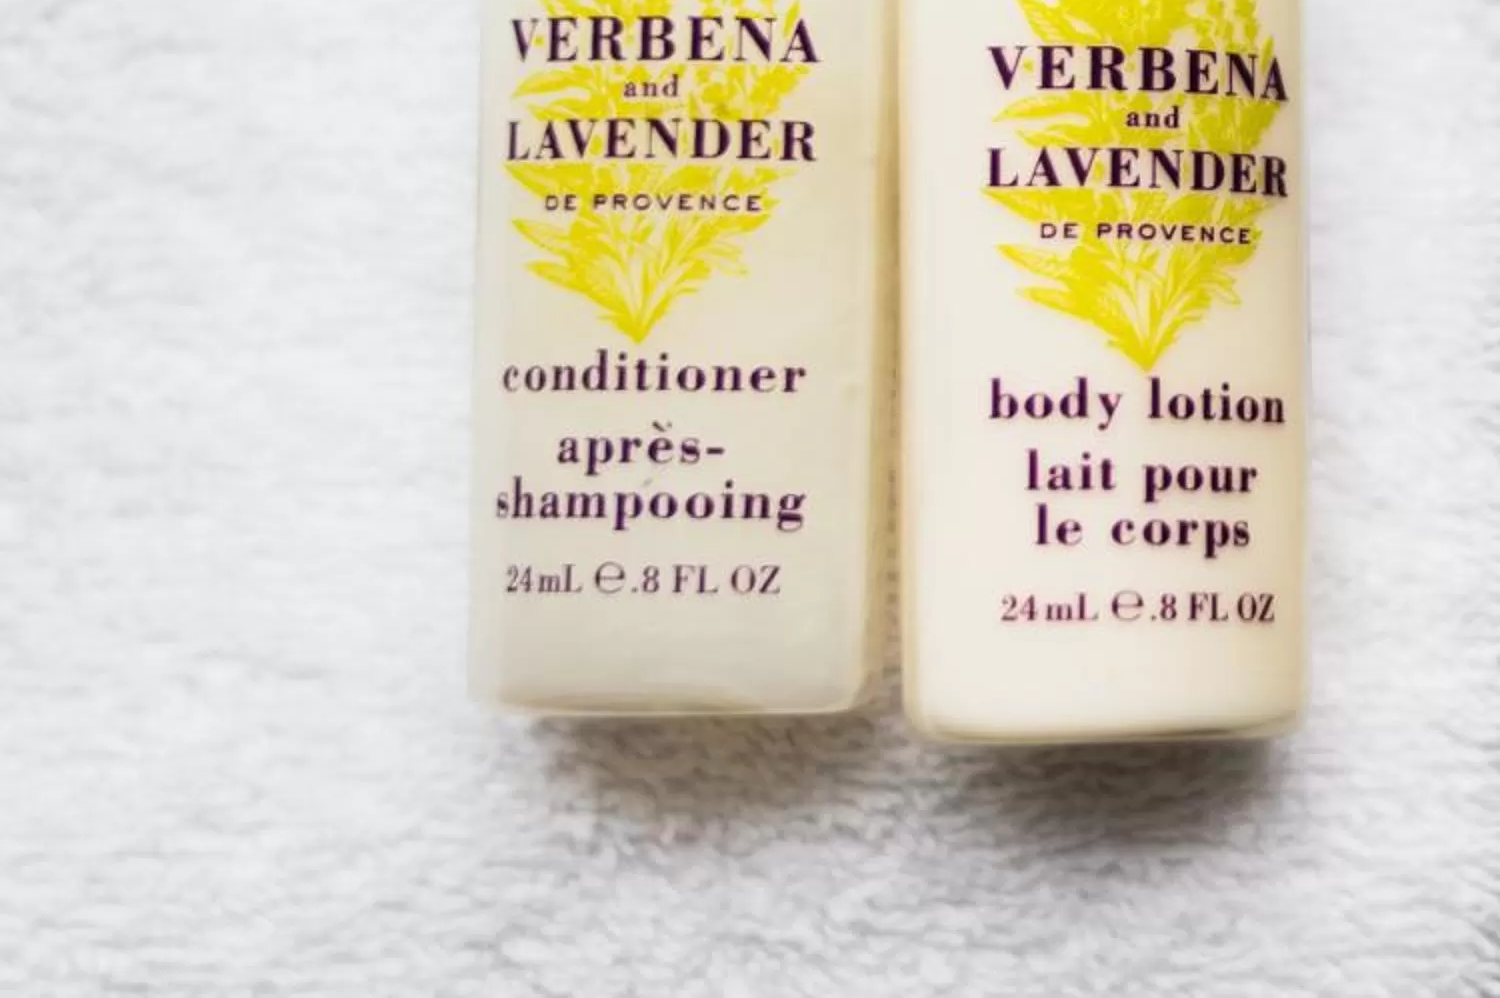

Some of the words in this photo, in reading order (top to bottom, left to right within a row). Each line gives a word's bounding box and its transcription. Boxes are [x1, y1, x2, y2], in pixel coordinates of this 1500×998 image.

[510, 15, 821, 63] VERBENA
[623, 74, 679, 98] and
[987, 45, 1289, 101] VERBENA
[507, 118, 817, 161] LAVENDER
[1125, 106, 1180, 129] and
[987, 147, 1288, 197] LAVENDER
[545, 195, 577, 211] DE
[594, 194, 761, 212] PROVENCE
[1040, 223, 1077, 239] DE
[1097, 223, 1250, 244] PROVENCE
[503, 348, 807, 394] conditioner
[989, 377, 1123, 430] body
[1148, 377, 1286, 423] lotion
[557, 422, 725, 476] après-
[1027, 448, 1116, 491] lait
[1143, 462, 1258, 502] pour
[496, 476, 807, 532] shampooing
[1035, 503, 1082, 545] le
[1111, 518, 1250, 559] corps
[672, 564, 718, 594] FL
[731, 565, 781, 595] OZ
[1188, 594, 1228, 621] FL
[1237, 594, 1275, 622] OZ
